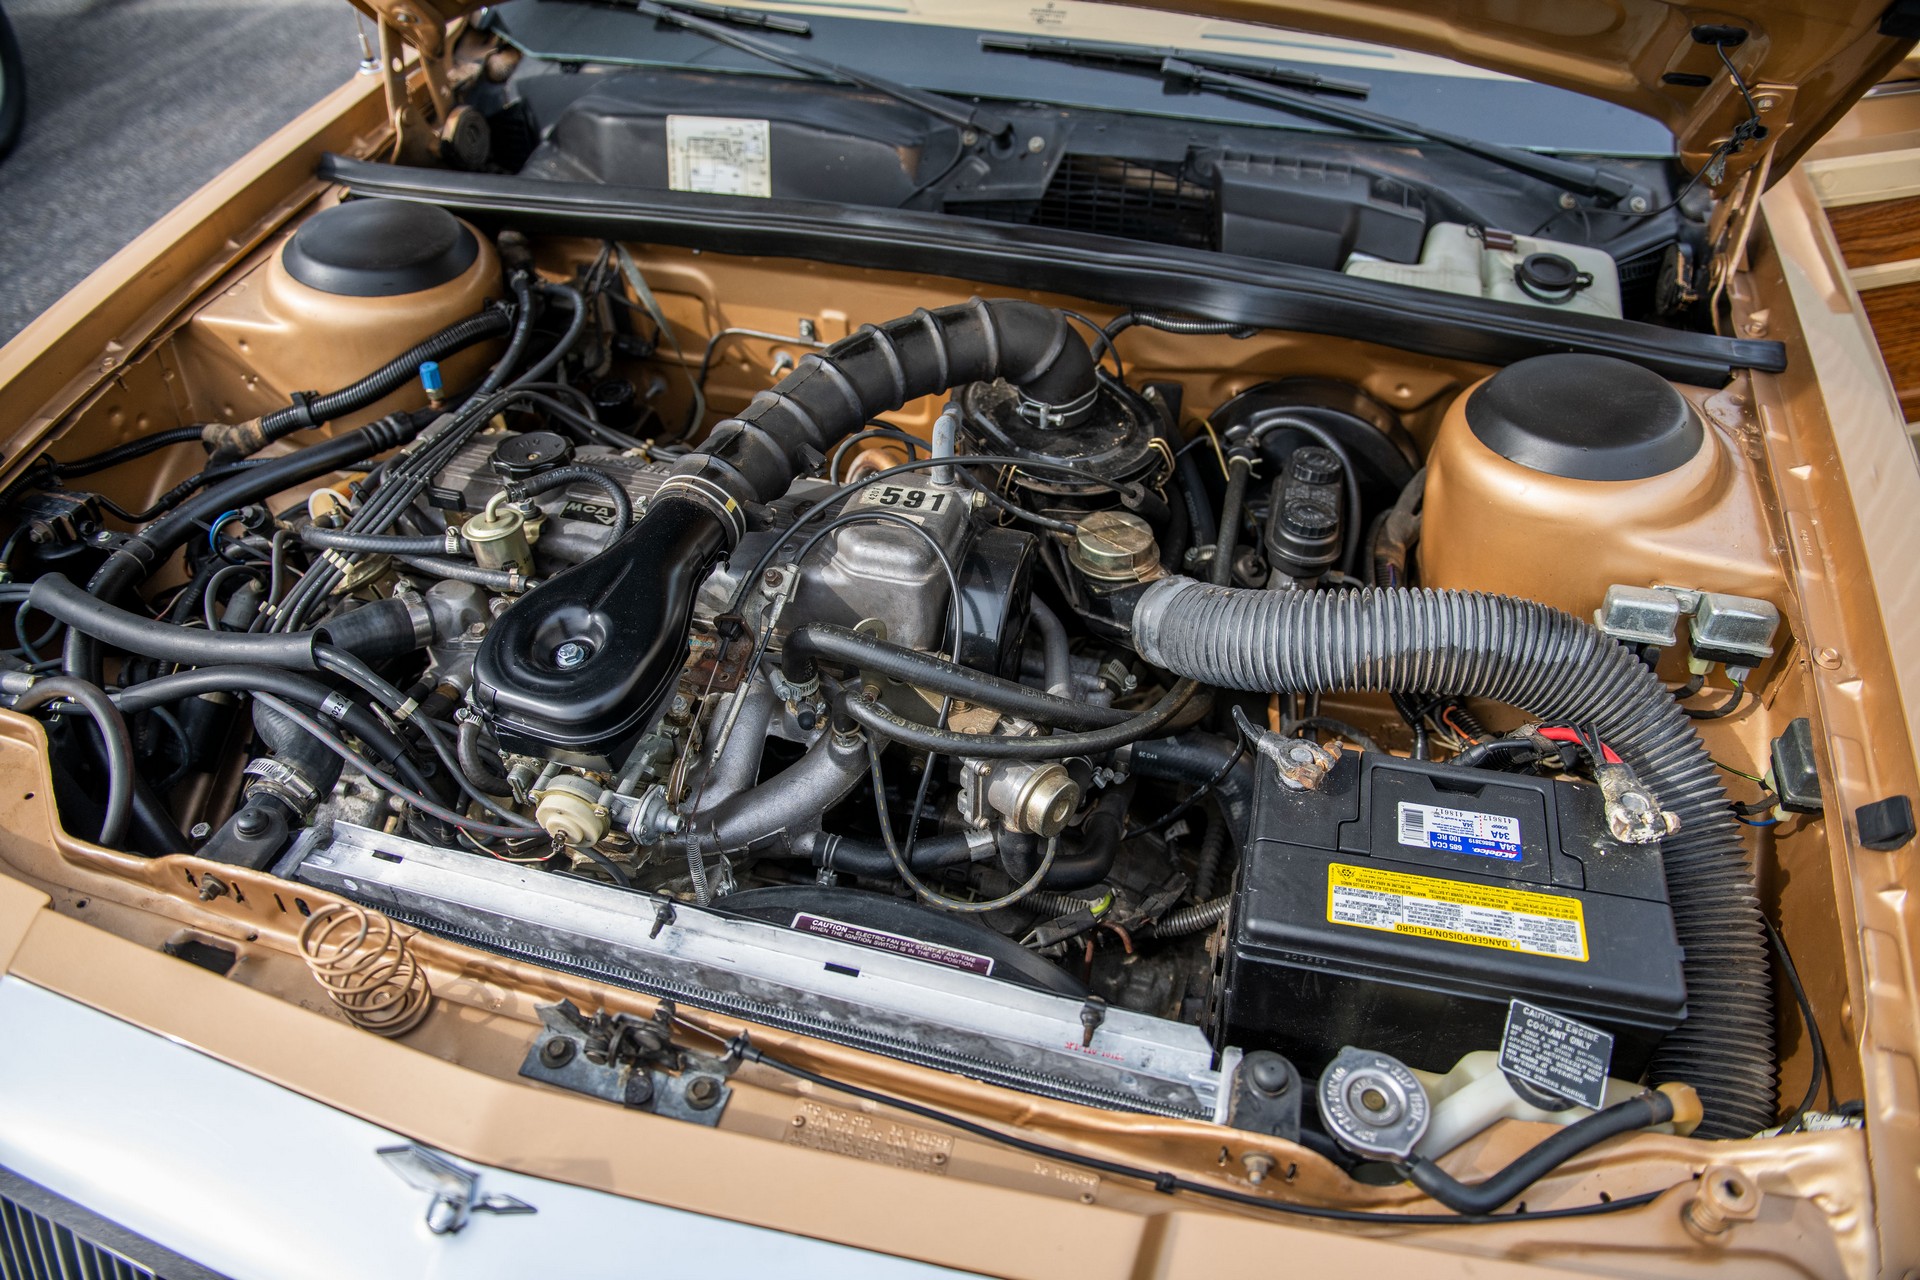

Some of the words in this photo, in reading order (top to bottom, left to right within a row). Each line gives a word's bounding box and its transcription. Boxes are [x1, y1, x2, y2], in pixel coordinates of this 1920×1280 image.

[566, 502, 609, 515] MCA
[879, 486, 946, 512] 591
[1491, 831, 1509, 840] 34A
[812, 920, 848, 932] CAUTION
[855, 931, 886, 941] ELECTRIC
[915, 945, 936, 953] START
[1397, 924, 1507, 947] DANGER/POISON/PELIGRO
[844, 934, 872, 943] IGNITION
[873, 940, 898, 949] SWITCH
[943, 956, 974, 967] POSITION.
[1523, 1007, 1563, 1028] CAUTION:
[1565, 1023, 1599, 1043] ENGINE
[1526, 1019, 1567, 1041] COOLANT
[1569, 1035, 1592, 1051] ONLY
[1507, 1042, 1533, 1056] COOLANT
[1535, 1053, 1553, 1064] LEVEL
